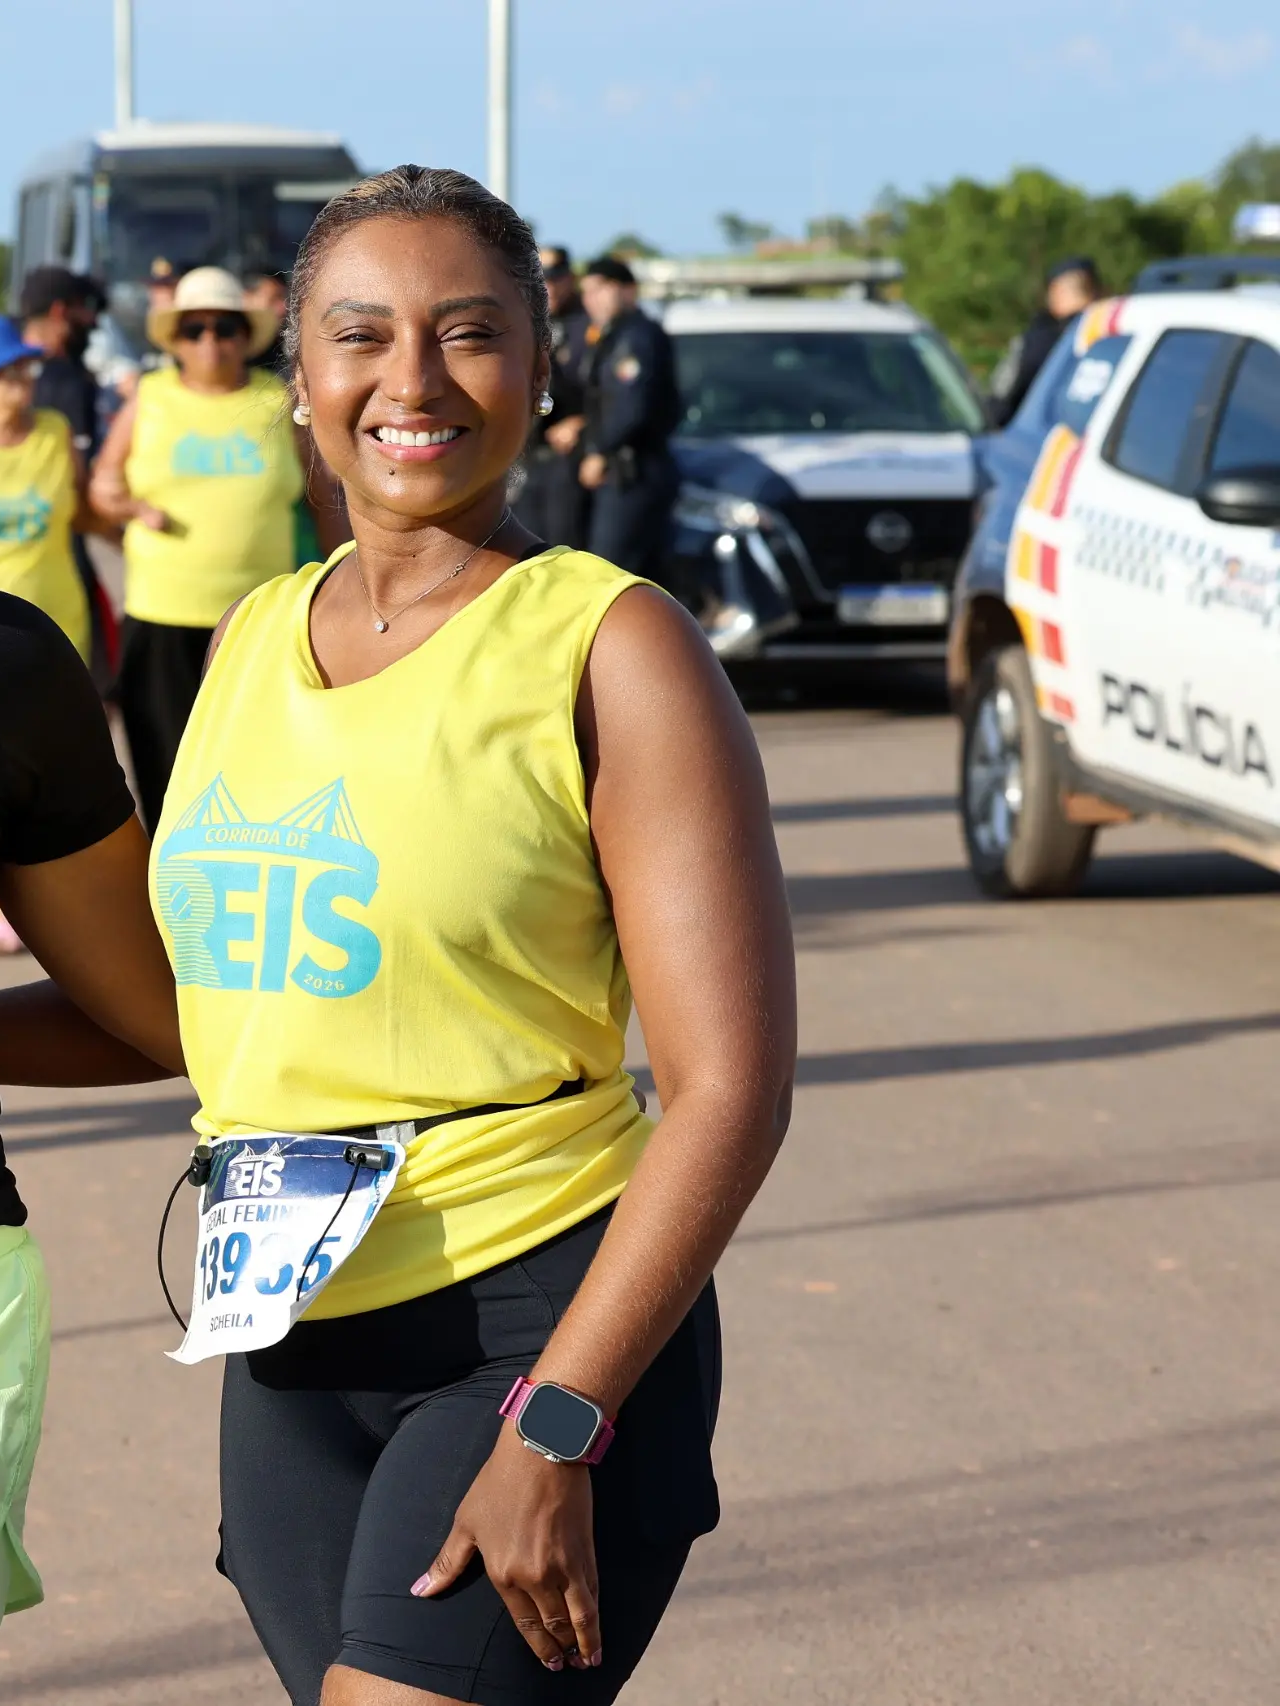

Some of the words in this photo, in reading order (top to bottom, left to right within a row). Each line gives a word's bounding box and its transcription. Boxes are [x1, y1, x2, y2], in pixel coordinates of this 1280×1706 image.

[1099, 671, 1275, 789] POLÍCIA
[205, 827, 280, 847] CORRIDA
[286, 832, 311, 850] DE
[156, 858, 382, 998] REIS
[304, 973, 346, 992] 2026
[223, 1161, 286, 1197] REIS
[209, 1313, 254, 1332] SCHEILA
